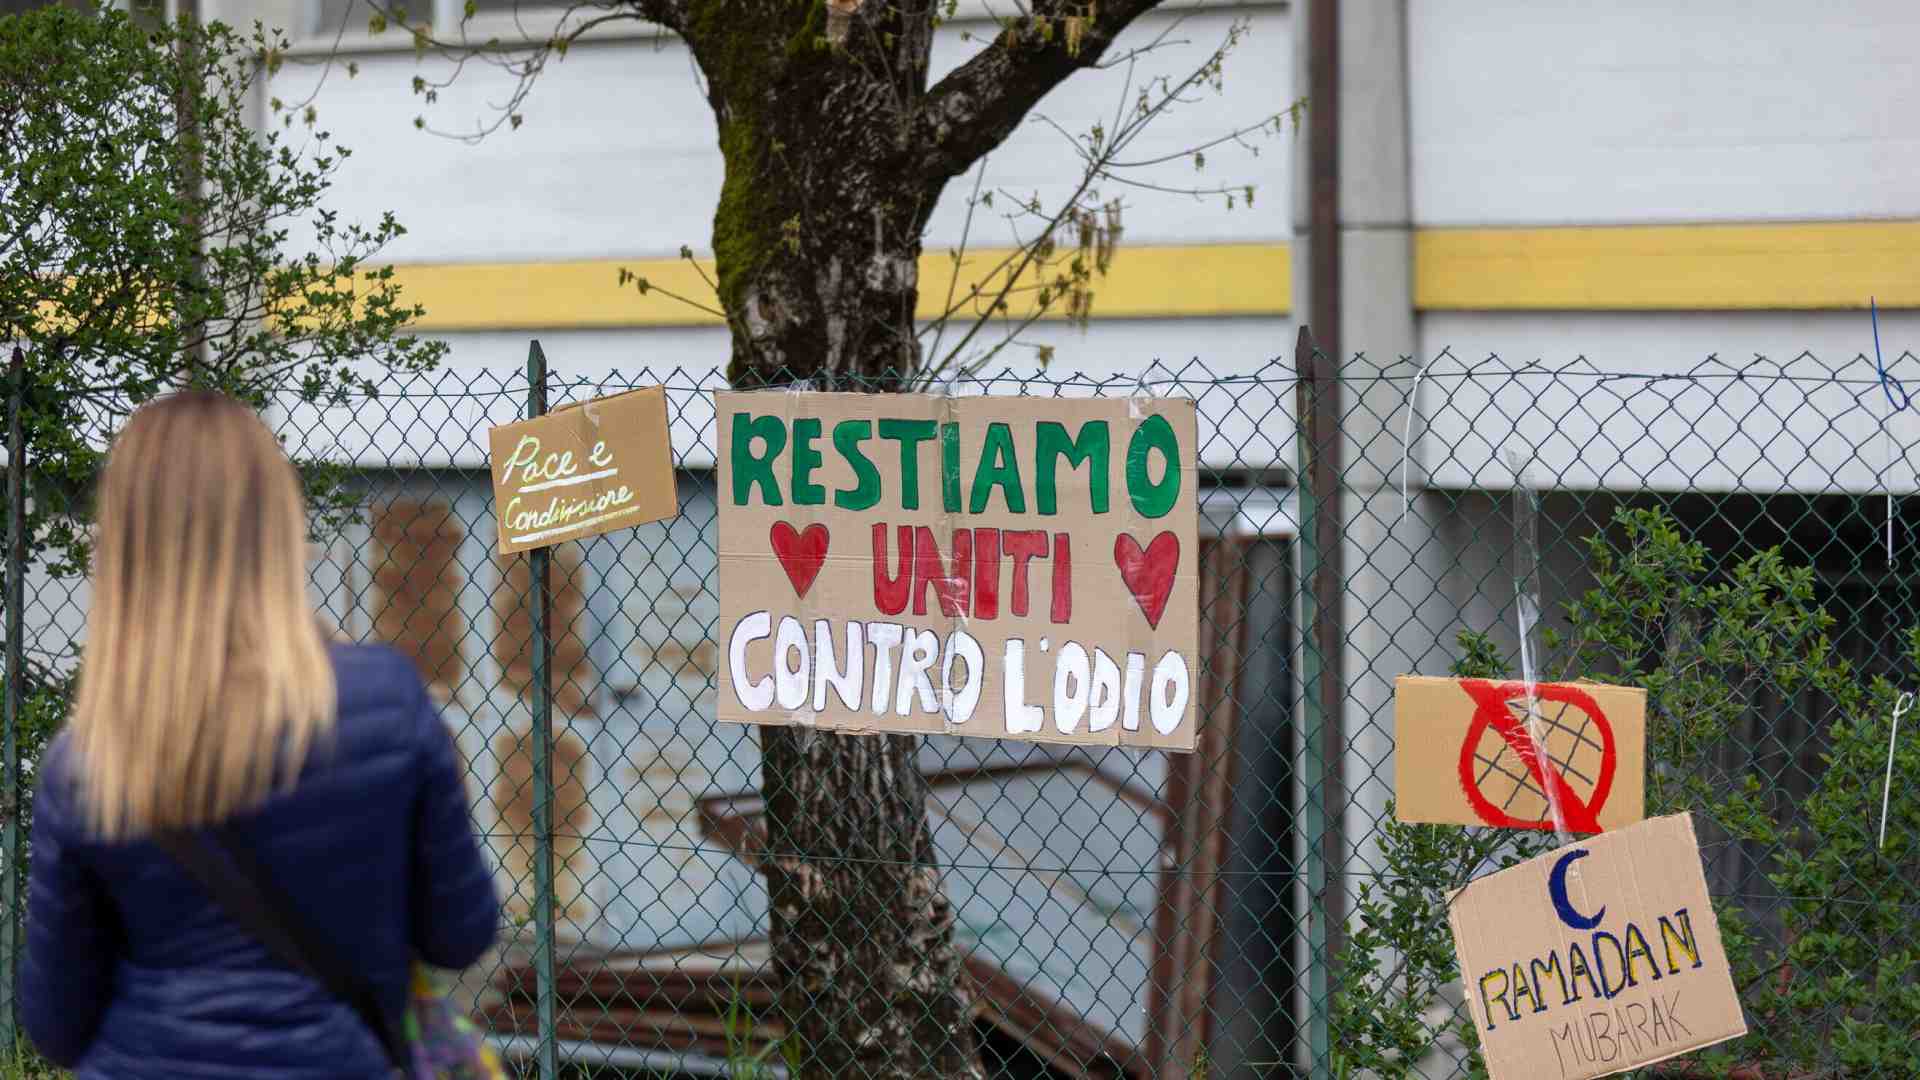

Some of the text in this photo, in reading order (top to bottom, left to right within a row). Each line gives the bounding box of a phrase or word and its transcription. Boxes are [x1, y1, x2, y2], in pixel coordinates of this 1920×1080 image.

[501, 434, 613, 484] Pace e
[731, 412, 1181, 519] RESTIAMO
[871, 522, 1073, 624] UNITI
[728, 610, 1190, 736] CONTRO L'ODIO
[1479, 908, 1703, 1031] RAMADAN
[1549, 991, 1692, 1077] MUBARAK
